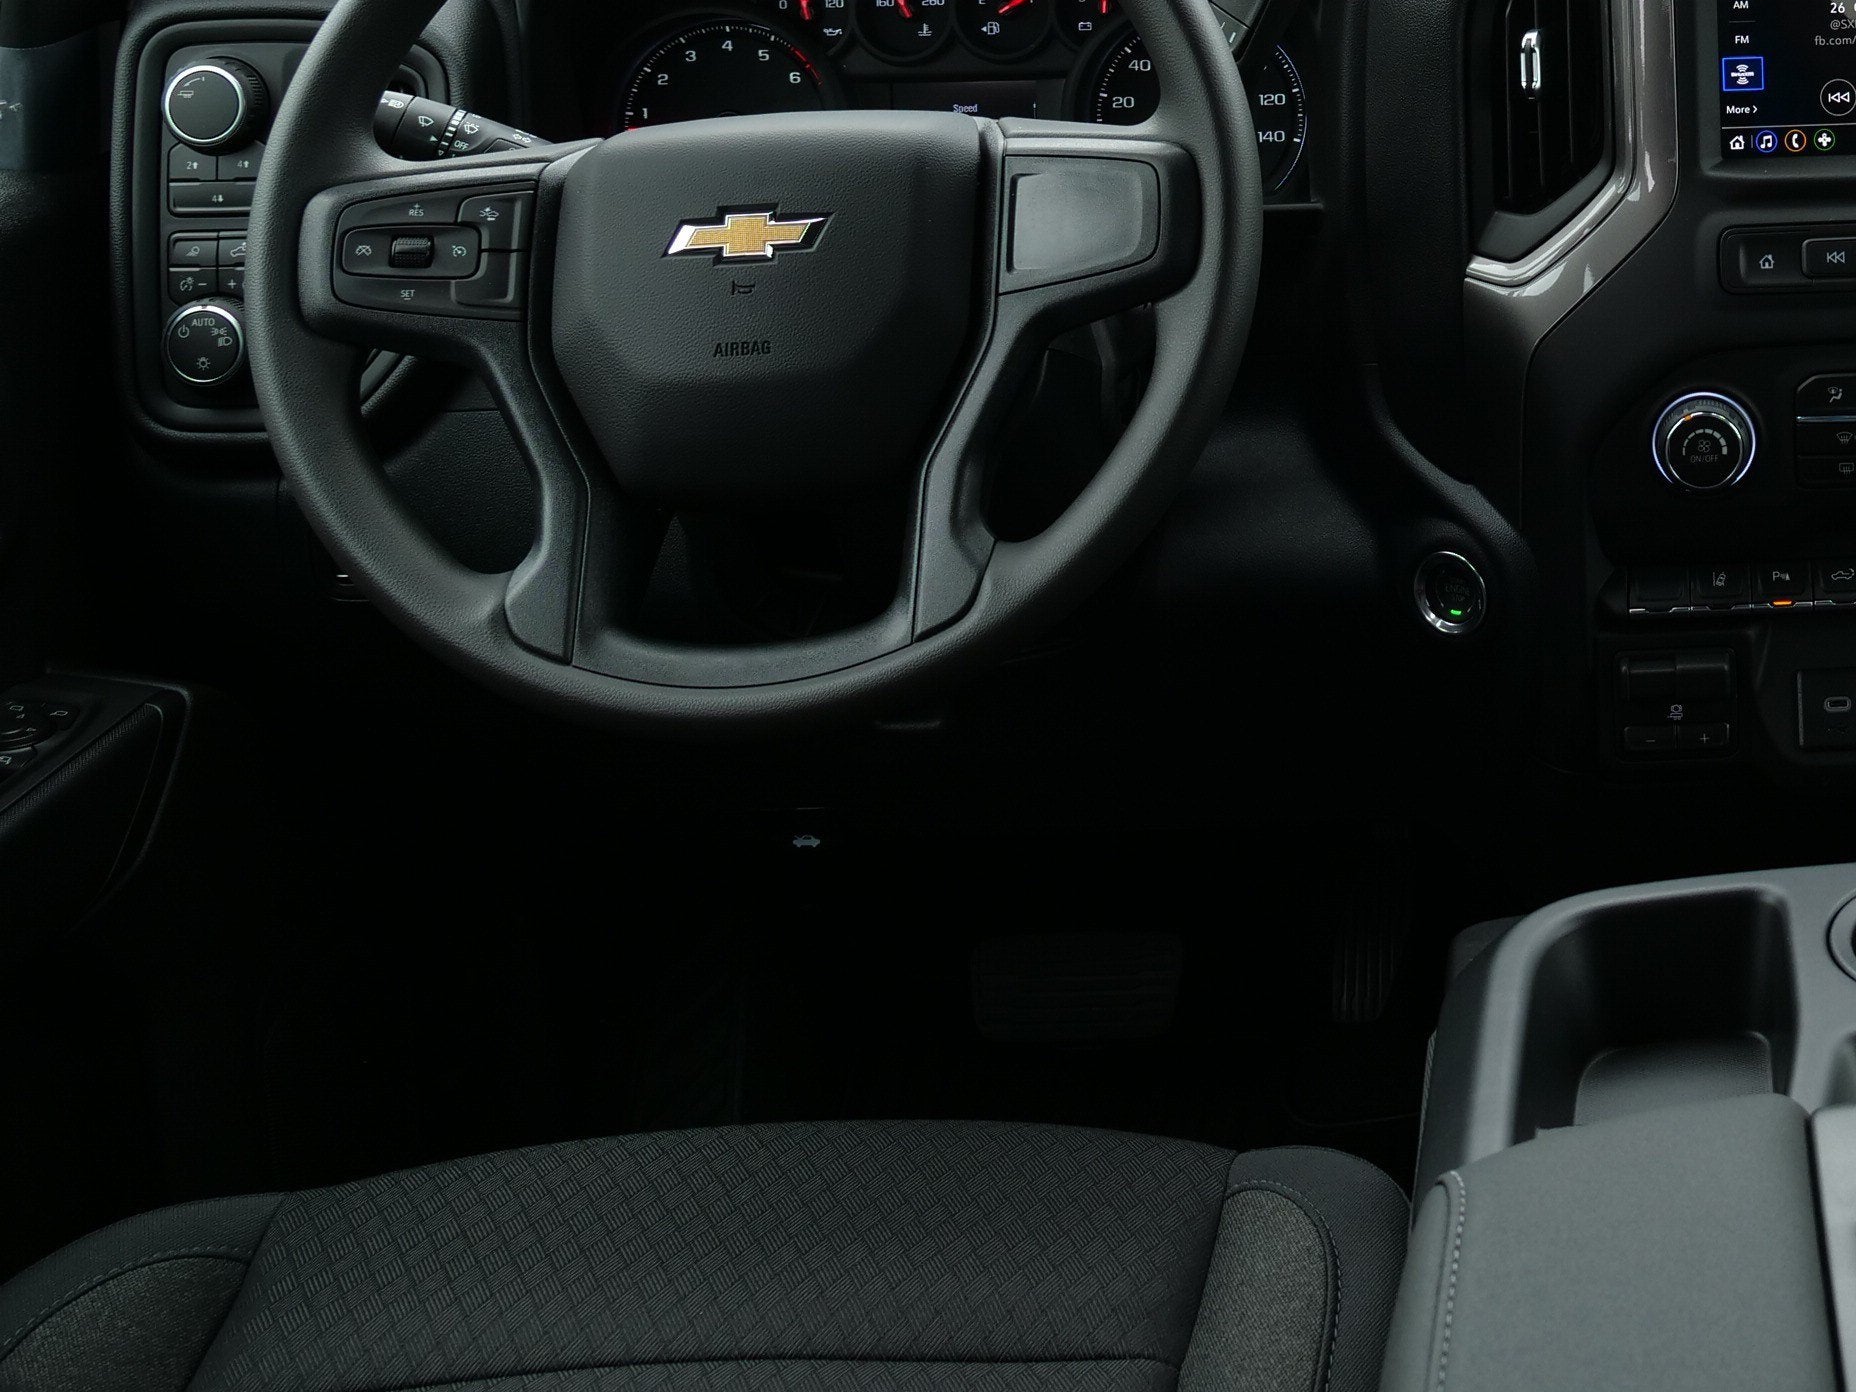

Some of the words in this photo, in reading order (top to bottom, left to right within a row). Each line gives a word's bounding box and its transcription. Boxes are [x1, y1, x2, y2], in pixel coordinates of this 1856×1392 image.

[778, 0, 788, 10] 0
[1733, 0, 1749, 10] AM
[1830, 2, 1846, 14] 26
[721, 40, 733, 51] 4
[1735, 35, 1750, 45] FM
[685, 50, 697, 62] 3
[757, 49, 770, 61] 5
[1128, 59, 1151, 72] 40
[657, 73, 669, 86] 2
[788, 71, 802, 83] 6
[1112, 96, 1135, 109] 20
[1258, 93, 1286, 106] 120
[642, 108, 648, 119] 1
[952, 103, 978, 113] Speed
[1726, 105, 1750, 115] More
[1257, 130, 1285, 142] 140
[453, 140, 469, 150] OFF
[408, 208, 424, 218] RES
[400, 289, 415, 299] SET
[191, 318, 216, 328] AUTO
[713, 341, 771, 358] AIRBAG
[1690, 454, 1719, 463] ON/OFF
